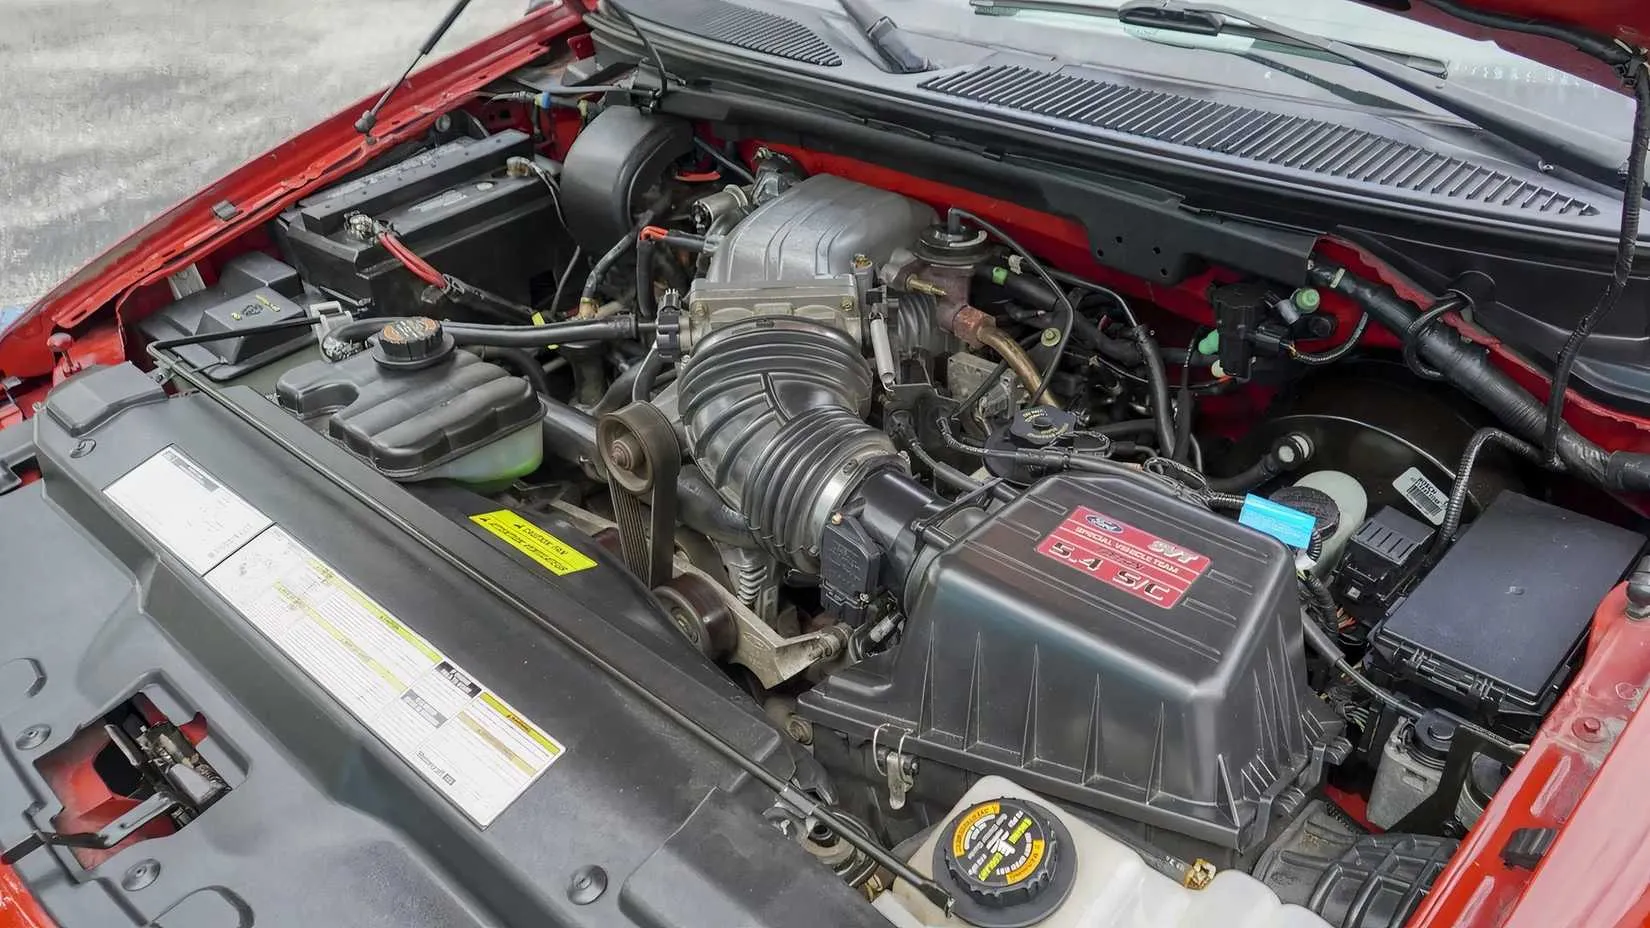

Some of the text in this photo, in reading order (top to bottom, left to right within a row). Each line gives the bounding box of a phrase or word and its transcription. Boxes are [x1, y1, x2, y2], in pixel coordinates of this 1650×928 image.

[1049, 541, 1104, 572] 5.4
[1112, 569, 1171, 601] S/C
[1075, 526, 1113, 546] SPECIAL
[1114, 541, 1154, 562] VEHICLE
[1153, 556, 1180, 574] TEAM
[1149, 540, 1200, 564] SVT
